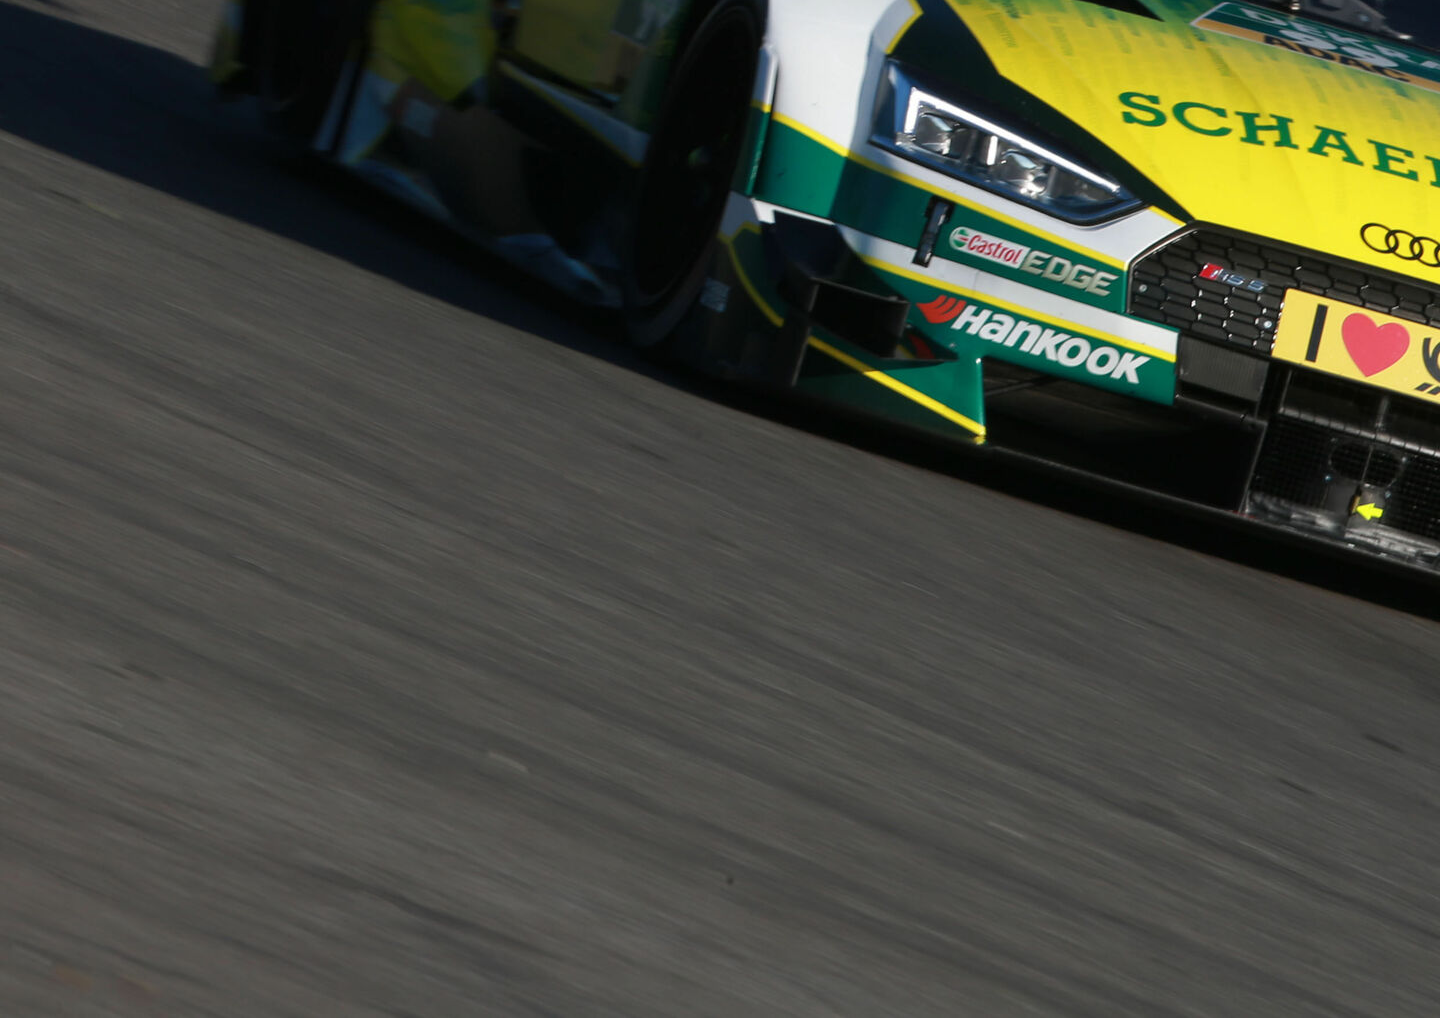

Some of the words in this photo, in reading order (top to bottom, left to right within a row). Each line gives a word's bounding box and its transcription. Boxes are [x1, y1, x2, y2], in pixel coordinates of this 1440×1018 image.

[966, 233, 1025, 263] Castrol
[1020, 250, 1119, 297] EDGE
[1305, 303, 1329, 363] I
